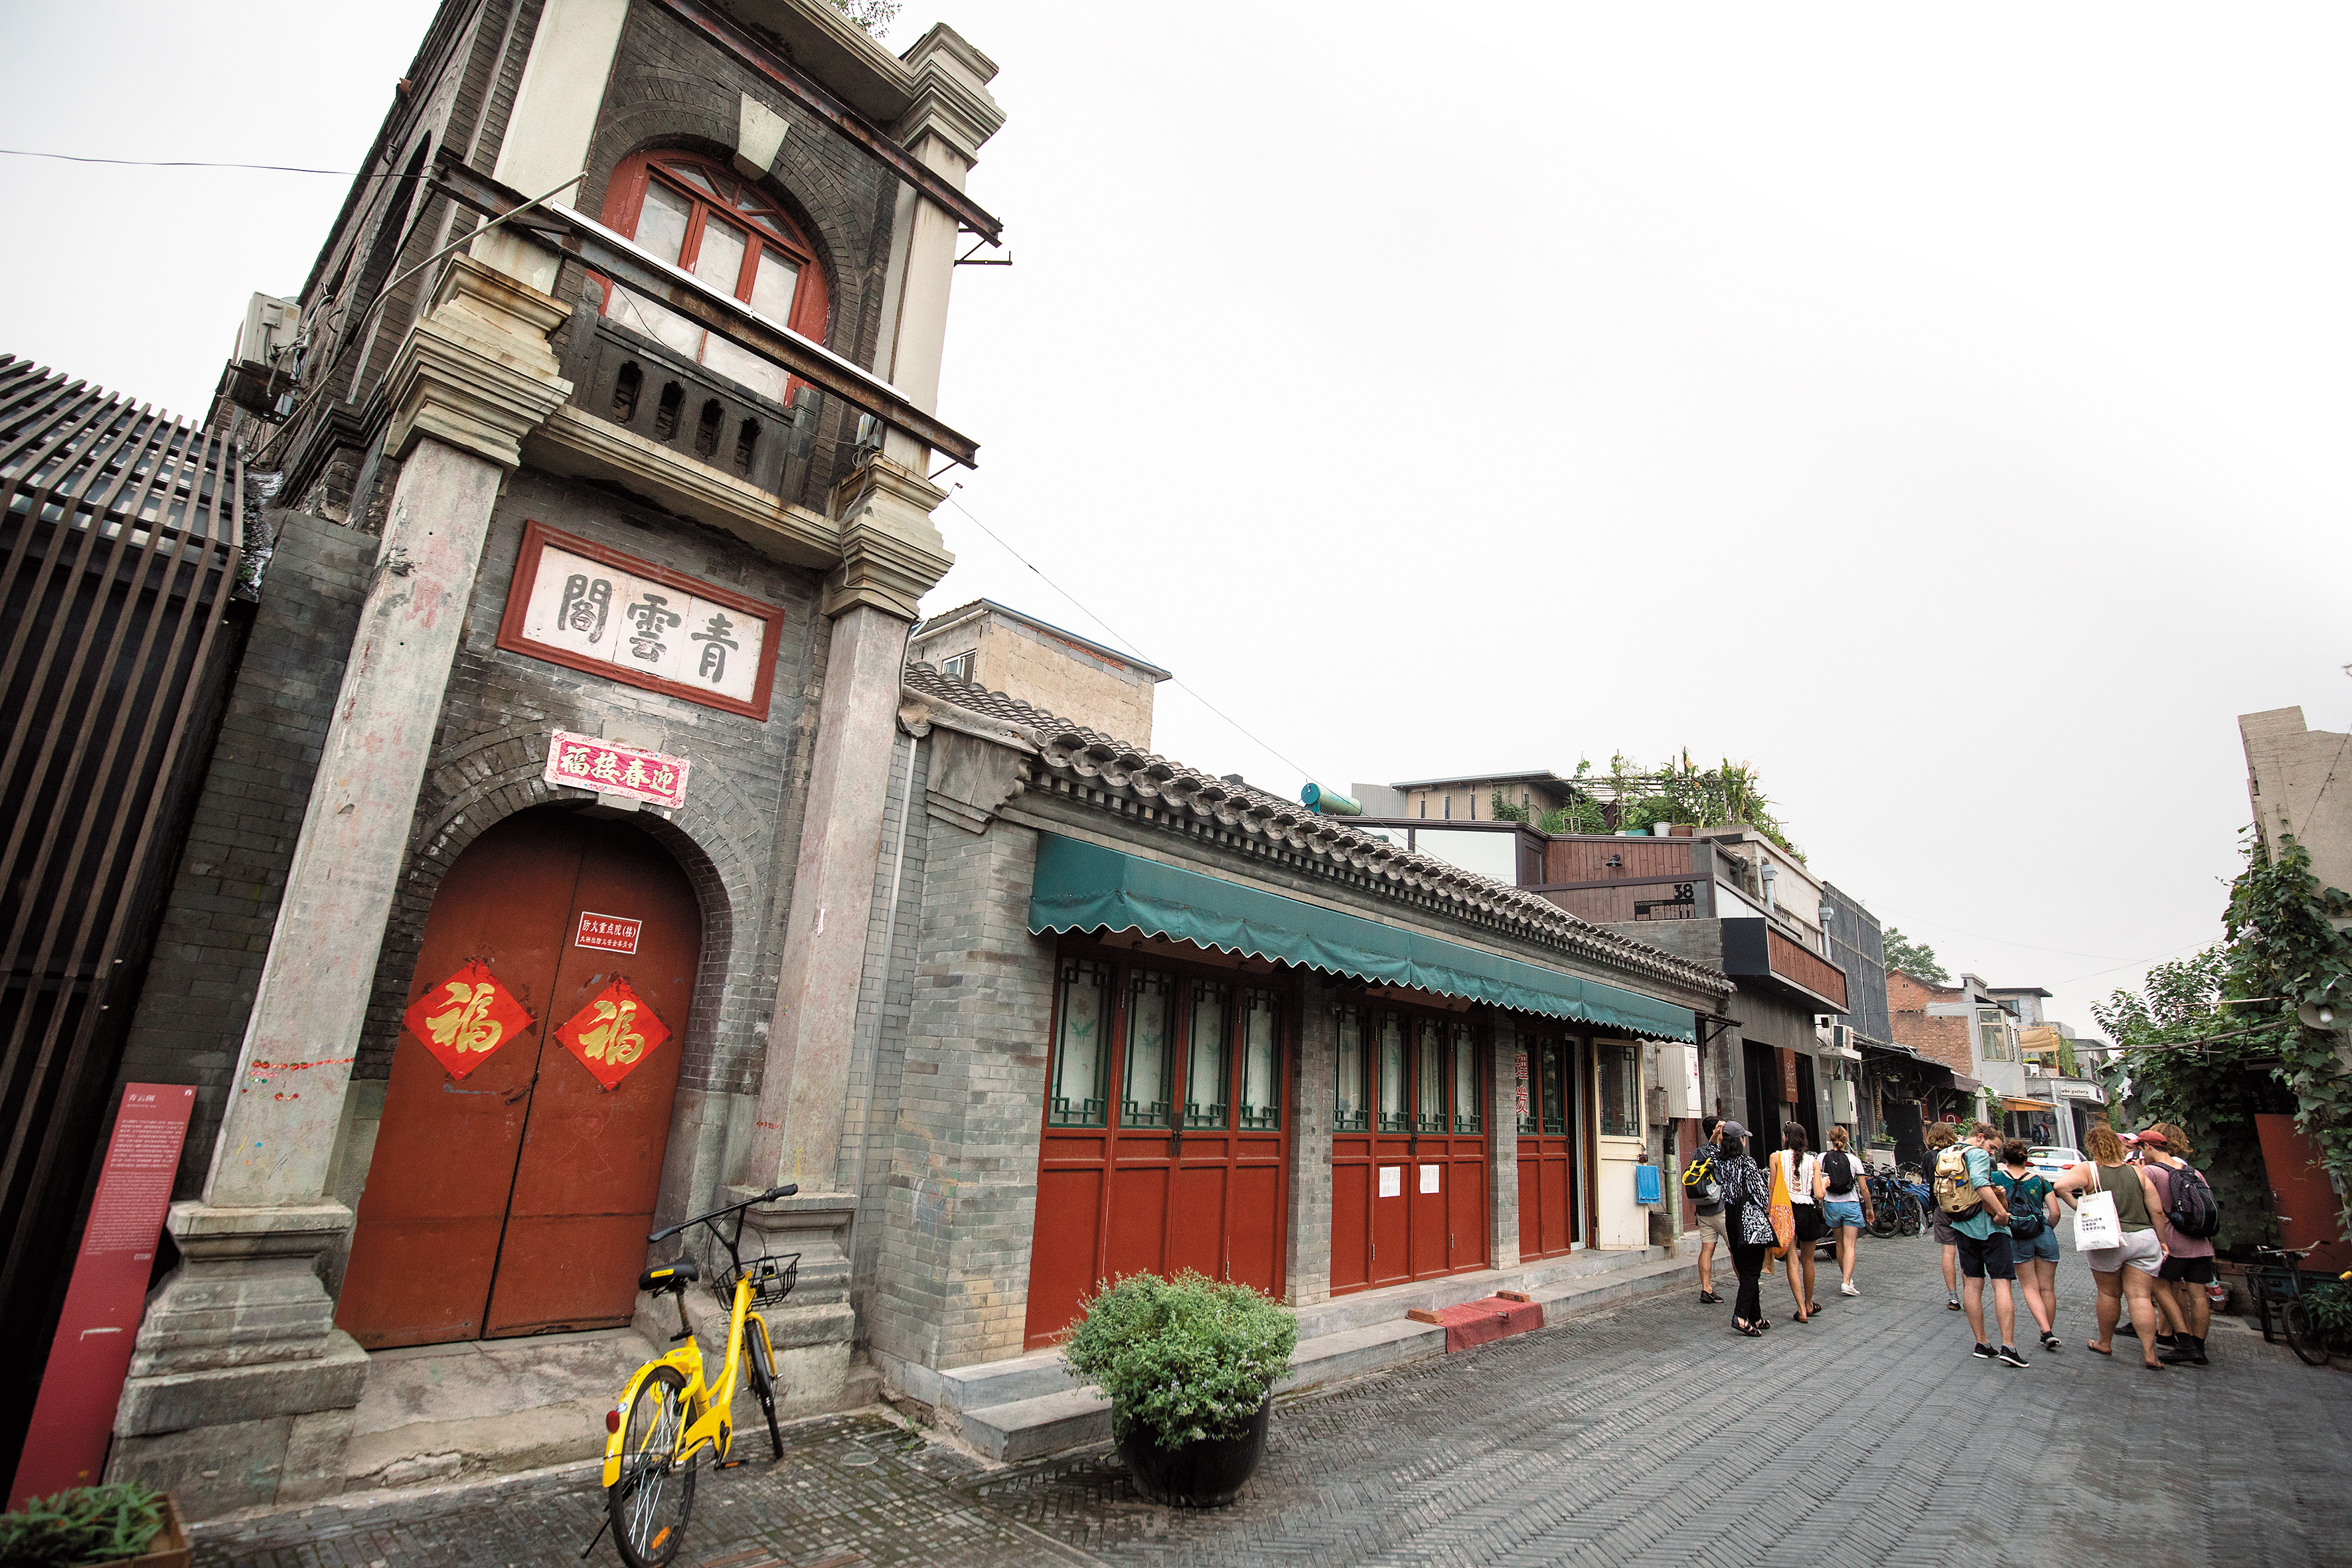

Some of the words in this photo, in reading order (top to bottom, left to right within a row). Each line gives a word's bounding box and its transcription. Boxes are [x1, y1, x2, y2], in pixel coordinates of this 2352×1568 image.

[557, 574, 739, 683] 青雲閣
[560, 745, 674, 795] 迎春接福
[1674, 884, 1694, 899] 38
[425, 981, 503, 1054] 福
[578, 1000, 645, 1066] 福
[1515, 1054, 1529, 1115] 理发
